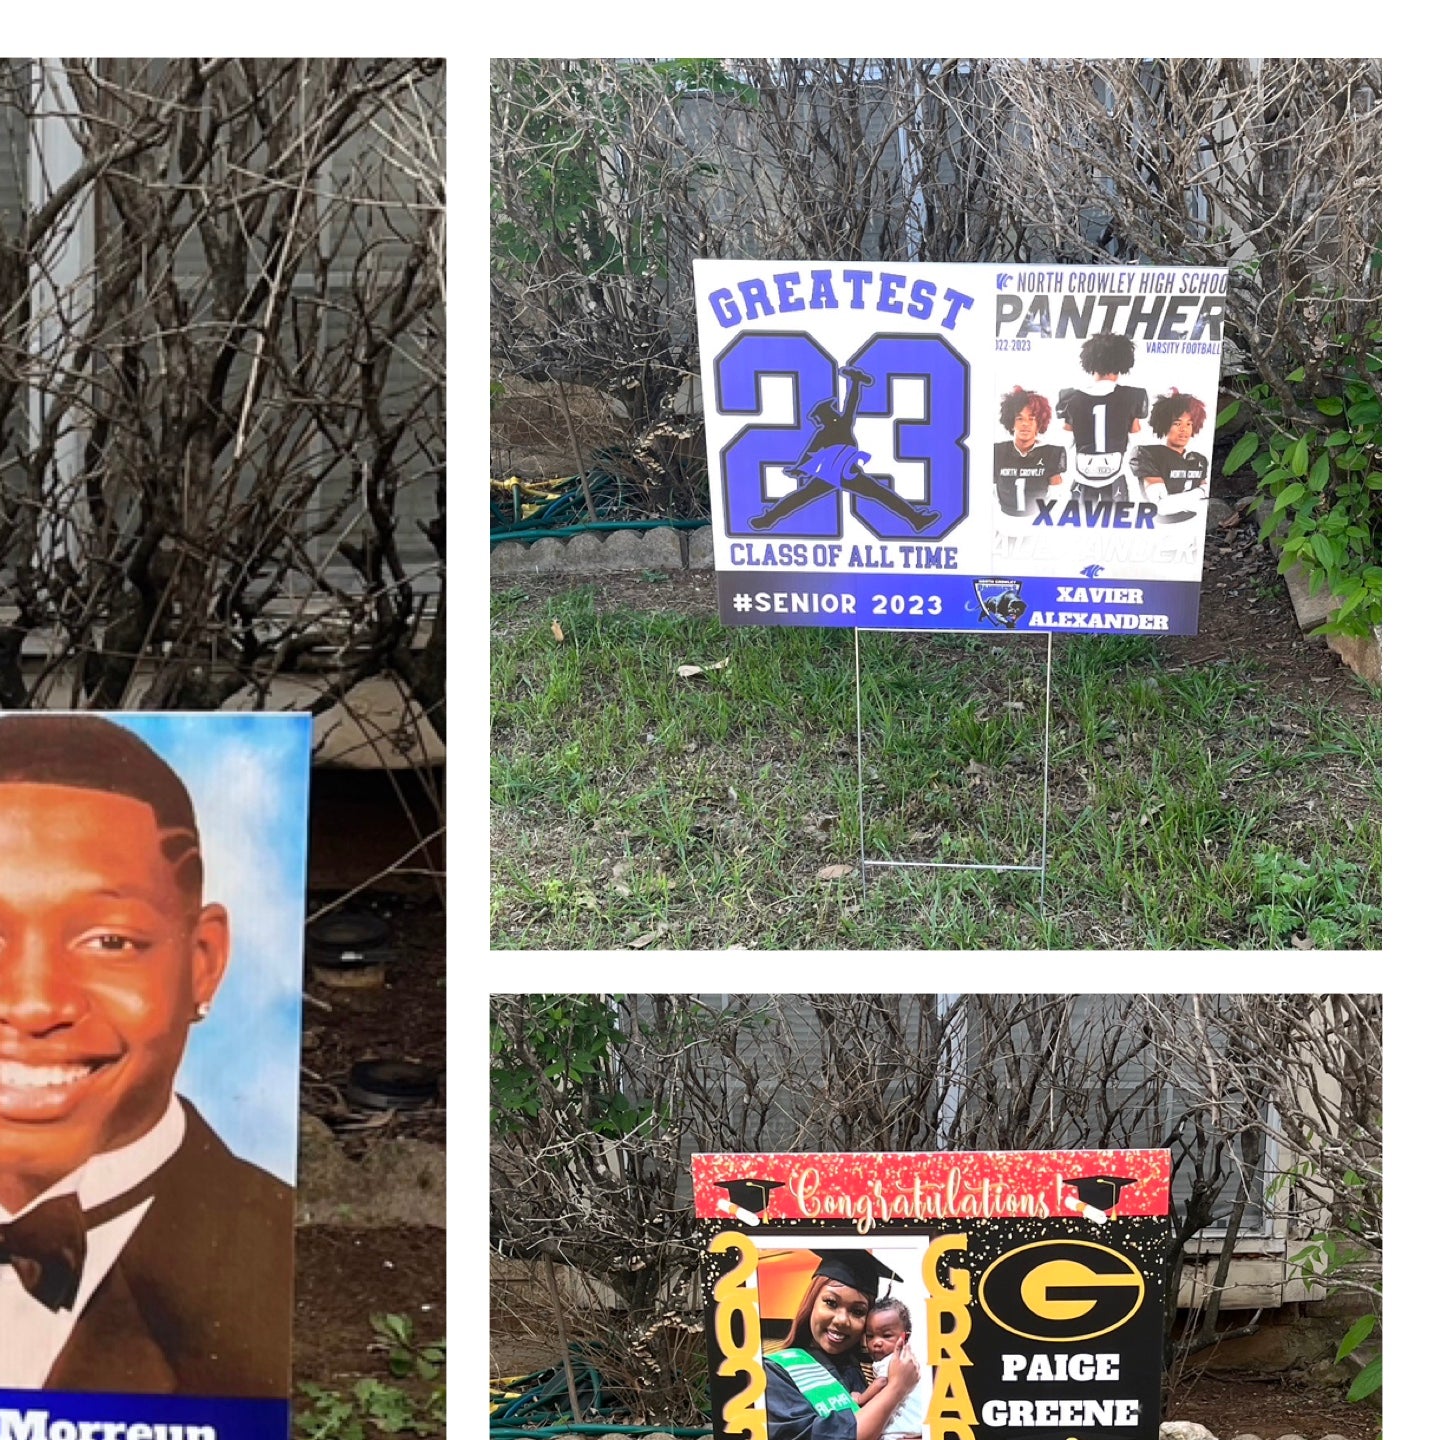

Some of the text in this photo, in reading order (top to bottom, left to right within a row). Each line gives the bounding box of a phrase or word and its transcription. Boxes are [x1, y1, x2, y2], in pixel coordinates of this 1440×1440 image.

[1017, 272, 1064, 292] NORTH
[1069, 272, 1136, 294] CROWLEY
[1139, 272, 1176, 294] HIGH
[708, 269, 975, 330] GREATEST
[996, 339, 1031, 351] 22-2023
[1146, 342, 1221, 354] VARSITY FOOTBALL
[713, 329, 971, 542] 23
[1092, 404, 1107, 453] 1
[1015, 478, 1026, 511] 1
[1032, 498, 1159, 530] XAVIER
[730, 543, 958, 570] CLASS OF ALL TIME
[732, 592, 942, 615] #SENIOR 2023
[1056, 586, 1144, 604] XAVIER
[1028, 611, 1169, 631] ALEXANDER
[790, 1167, 1062, 1234] Congratulations!
[1002, 1353, 1120, 1382] PAIGE
[981, 1399, 1139, 1427] GREENE
